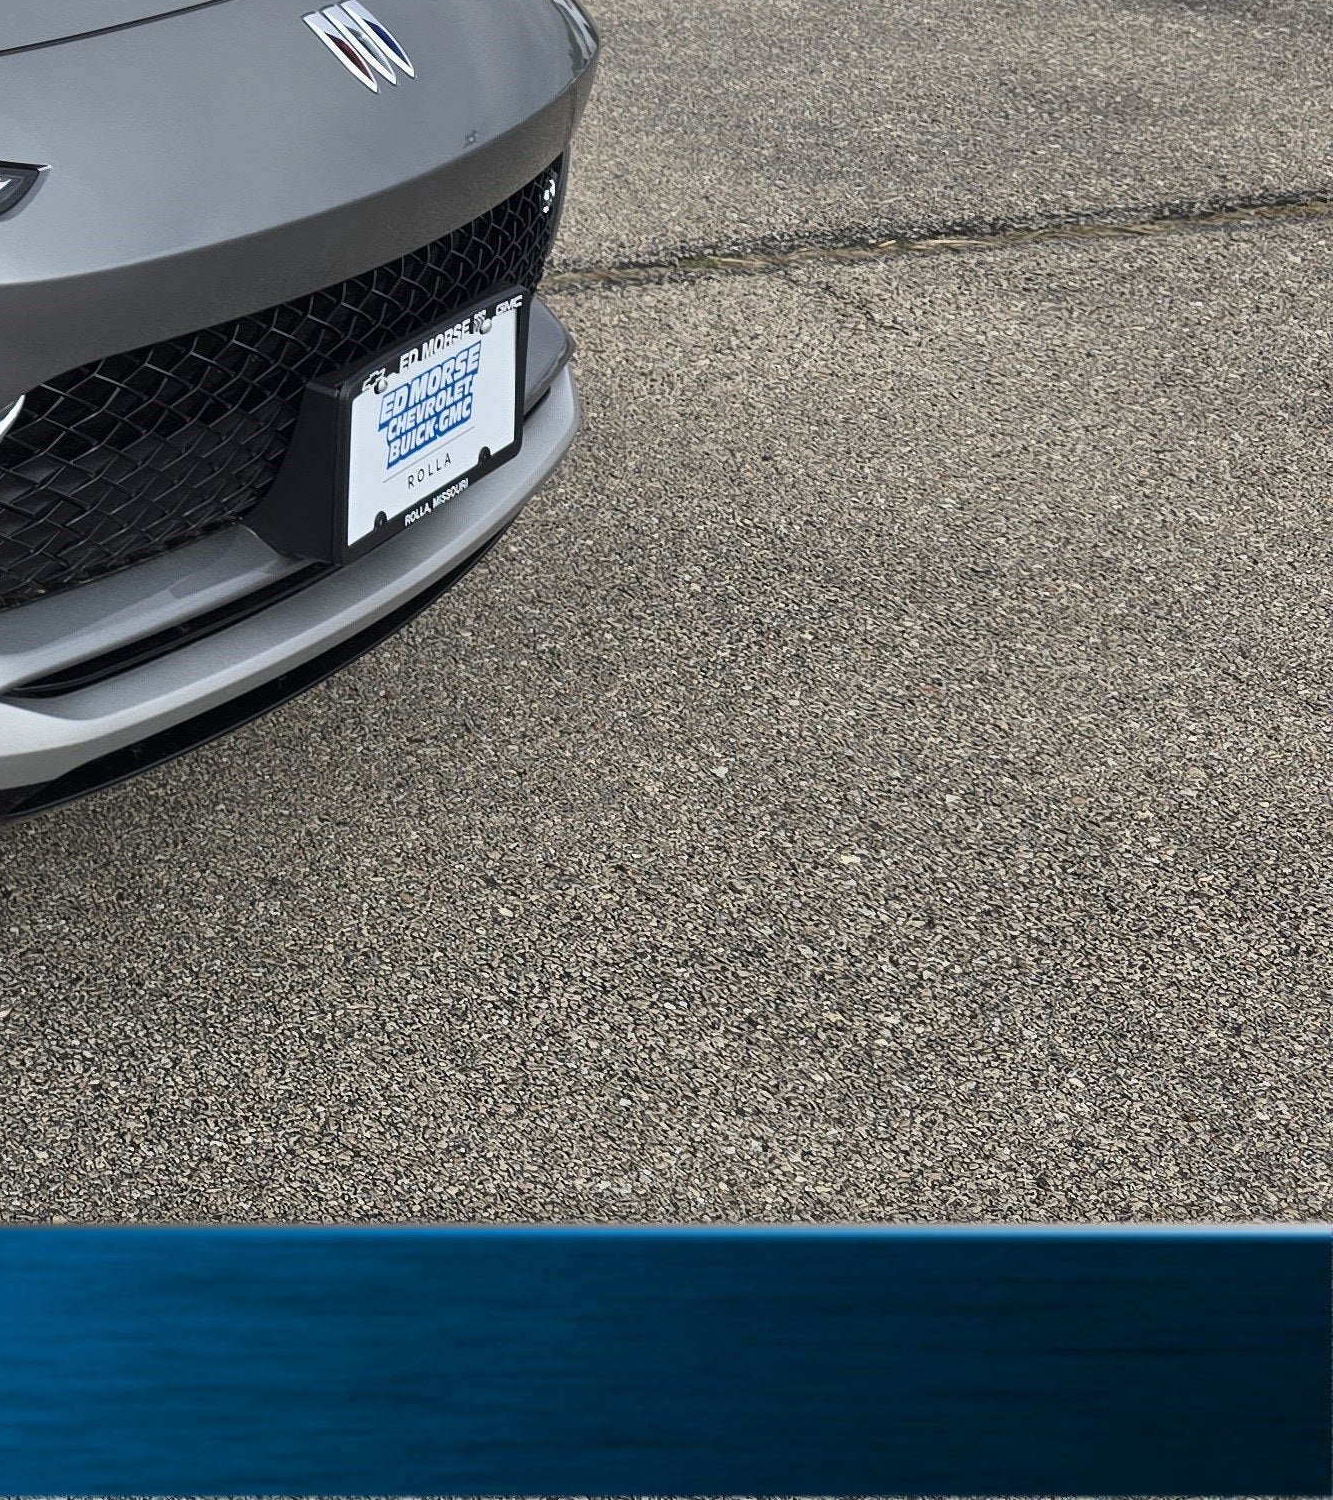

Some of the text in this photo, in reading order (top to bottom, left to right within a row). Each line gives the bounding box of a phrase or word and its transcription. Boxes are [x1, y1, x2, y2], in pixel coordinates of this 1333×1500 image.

[399, 347, 420, 374] ED
[421, 318, 471, 363] MORSE
[380, 341, 482, 423] ED MORSE
[387, 374, 473, 441] CHEVROLET
[407, 452, 452, 490] ROLLA
